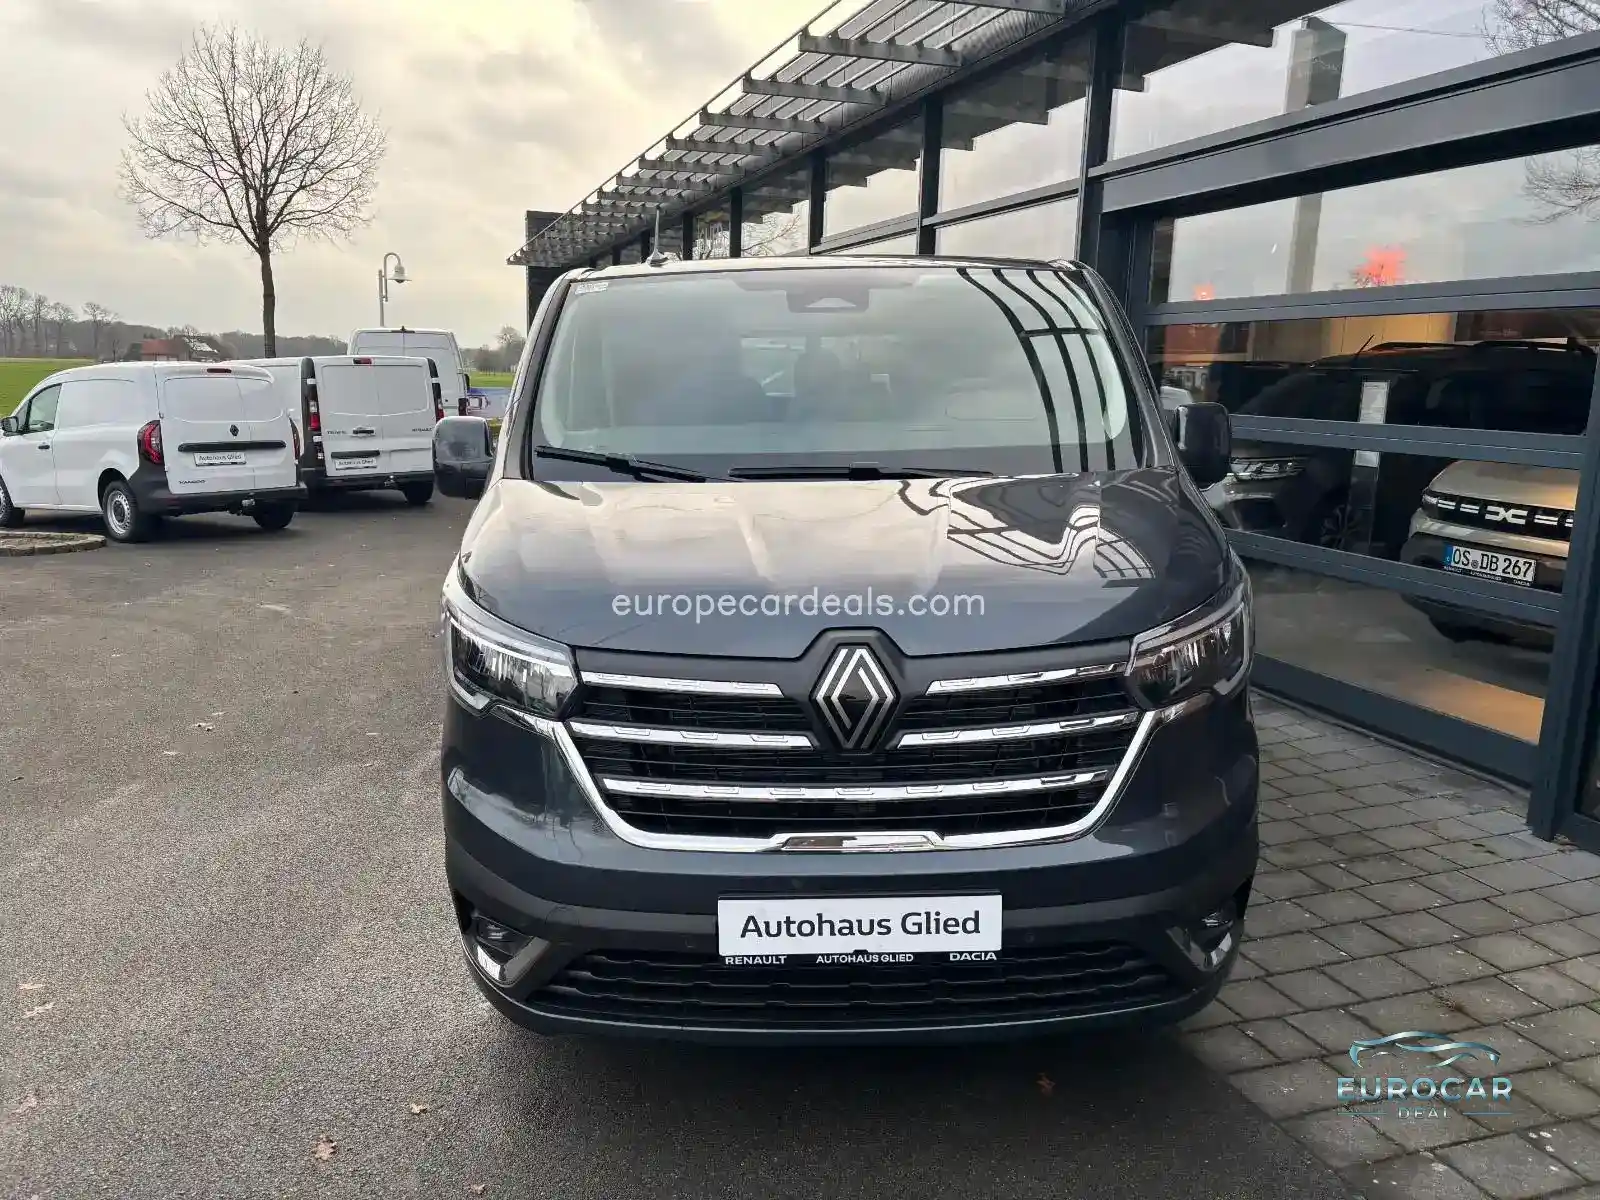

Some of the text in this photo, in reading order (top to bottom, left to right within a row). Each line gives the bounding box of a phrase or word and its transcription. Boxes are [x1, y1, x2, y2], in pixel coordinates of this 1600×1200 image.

[1453, 548, 1533, 578] OS DB 267
[740, 910, 981, 938] Autohaus Glied
[725, 955, 787, 965] RENAULT
[816, 953, 914, 964] AUTOHAUS GLIED
[949, 951, 997, 961] DACIA
